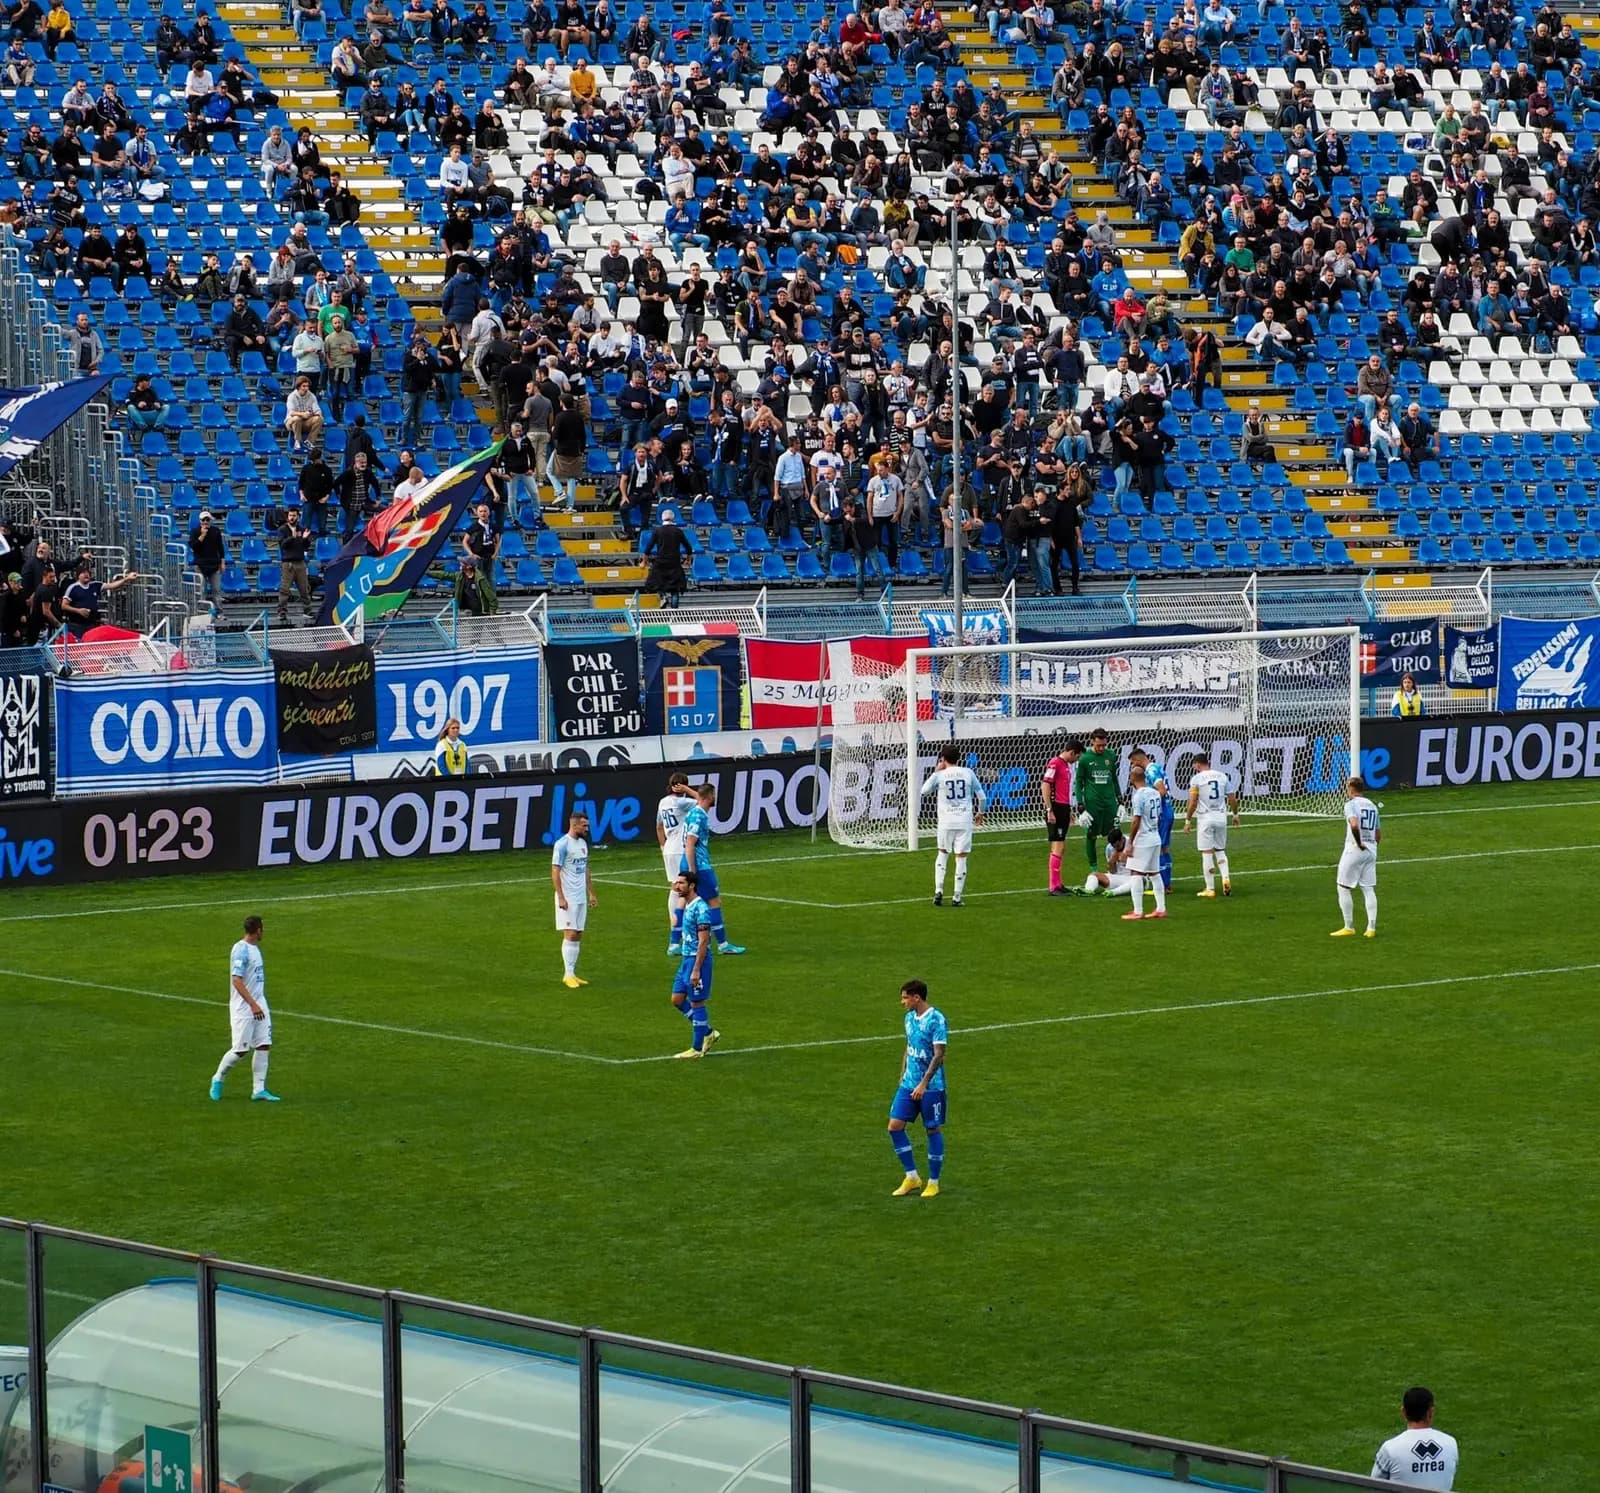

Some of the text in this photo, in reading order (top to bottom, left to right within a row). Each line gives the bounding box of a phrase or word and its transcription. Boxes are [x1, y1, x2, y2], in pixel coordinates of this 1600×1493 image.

[805, 439, 823, 449] COM
[1390, 629, 1432, 648] CLUB
[572, 653, 613, 672] PAR
[1391, 655, 1431, 673] URIO
[280, 661, 371, 690] maledetta
[567, 674, 605, 694] CHI
[764, 685, 785, 700] 25
[388, 674, 511, 742] 1907
[577, 694, 623, 714] CHE
[561, 710, 641, 737] GHÉ PÜ
[671, 713, 715, 727] 1907
[90, 696, 266, 765] COMO
[1416, 721, 1600, 787] EUROBE
[945, 779, 966, 800] 33
[1208, 780, 1219, 800] 3
[257, 784, 544, 866] EUROBET
[1361, 808, 1376, 831] 20
[83, 806, 214, 867] 01:23
[907, 1046, 926, 1058] OLA
[0, 1372, 28, 1392] EC
